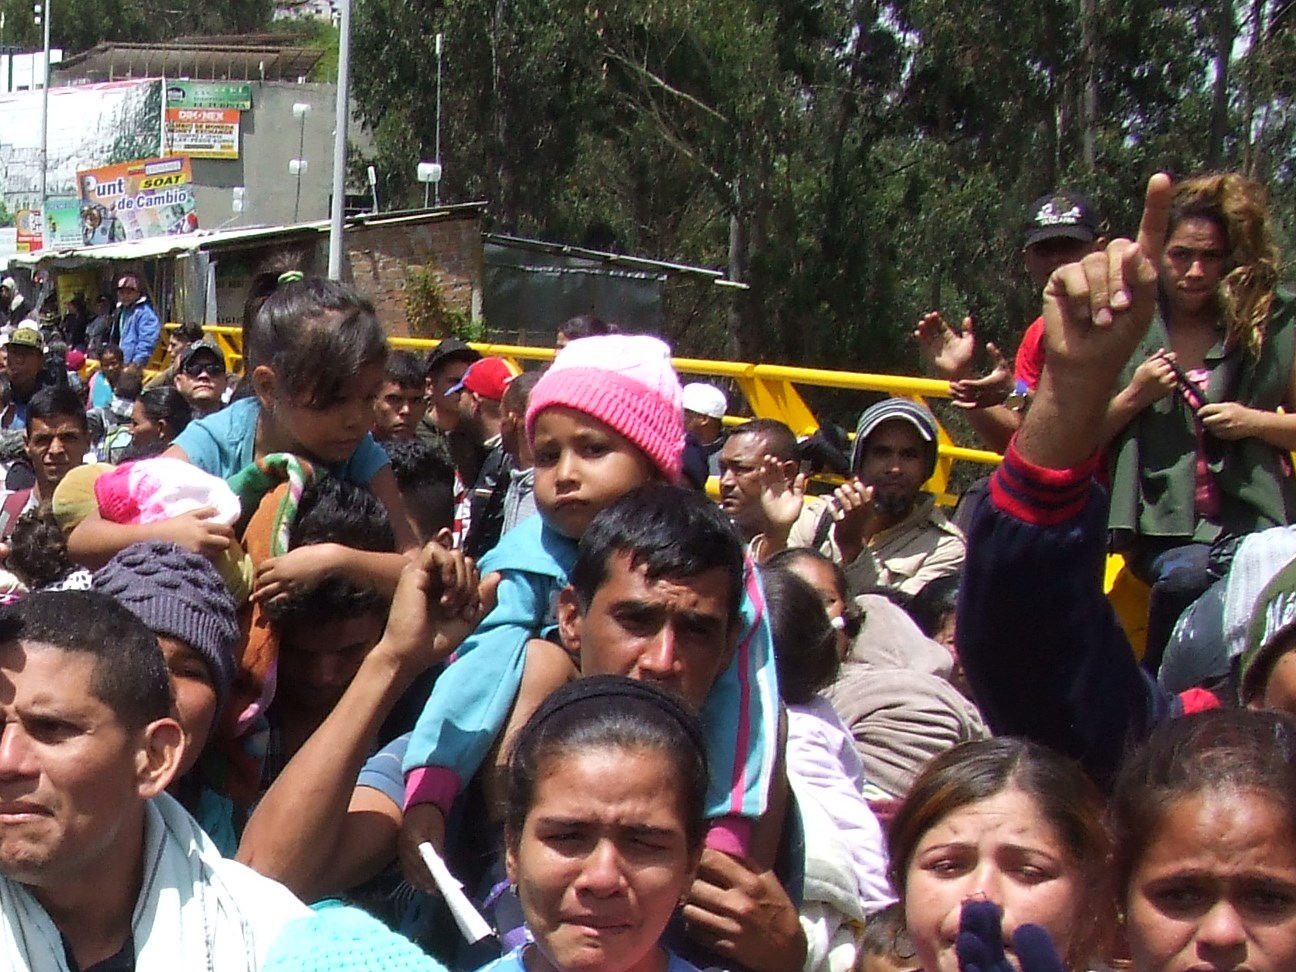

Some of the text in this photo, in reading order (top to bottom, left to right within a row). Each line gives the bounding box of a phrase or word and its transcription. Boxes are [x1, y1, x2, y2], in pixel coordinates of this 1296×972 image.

[143, 174, 182, 189] SOAT
[117, 189, 187, 210] de Cambio
